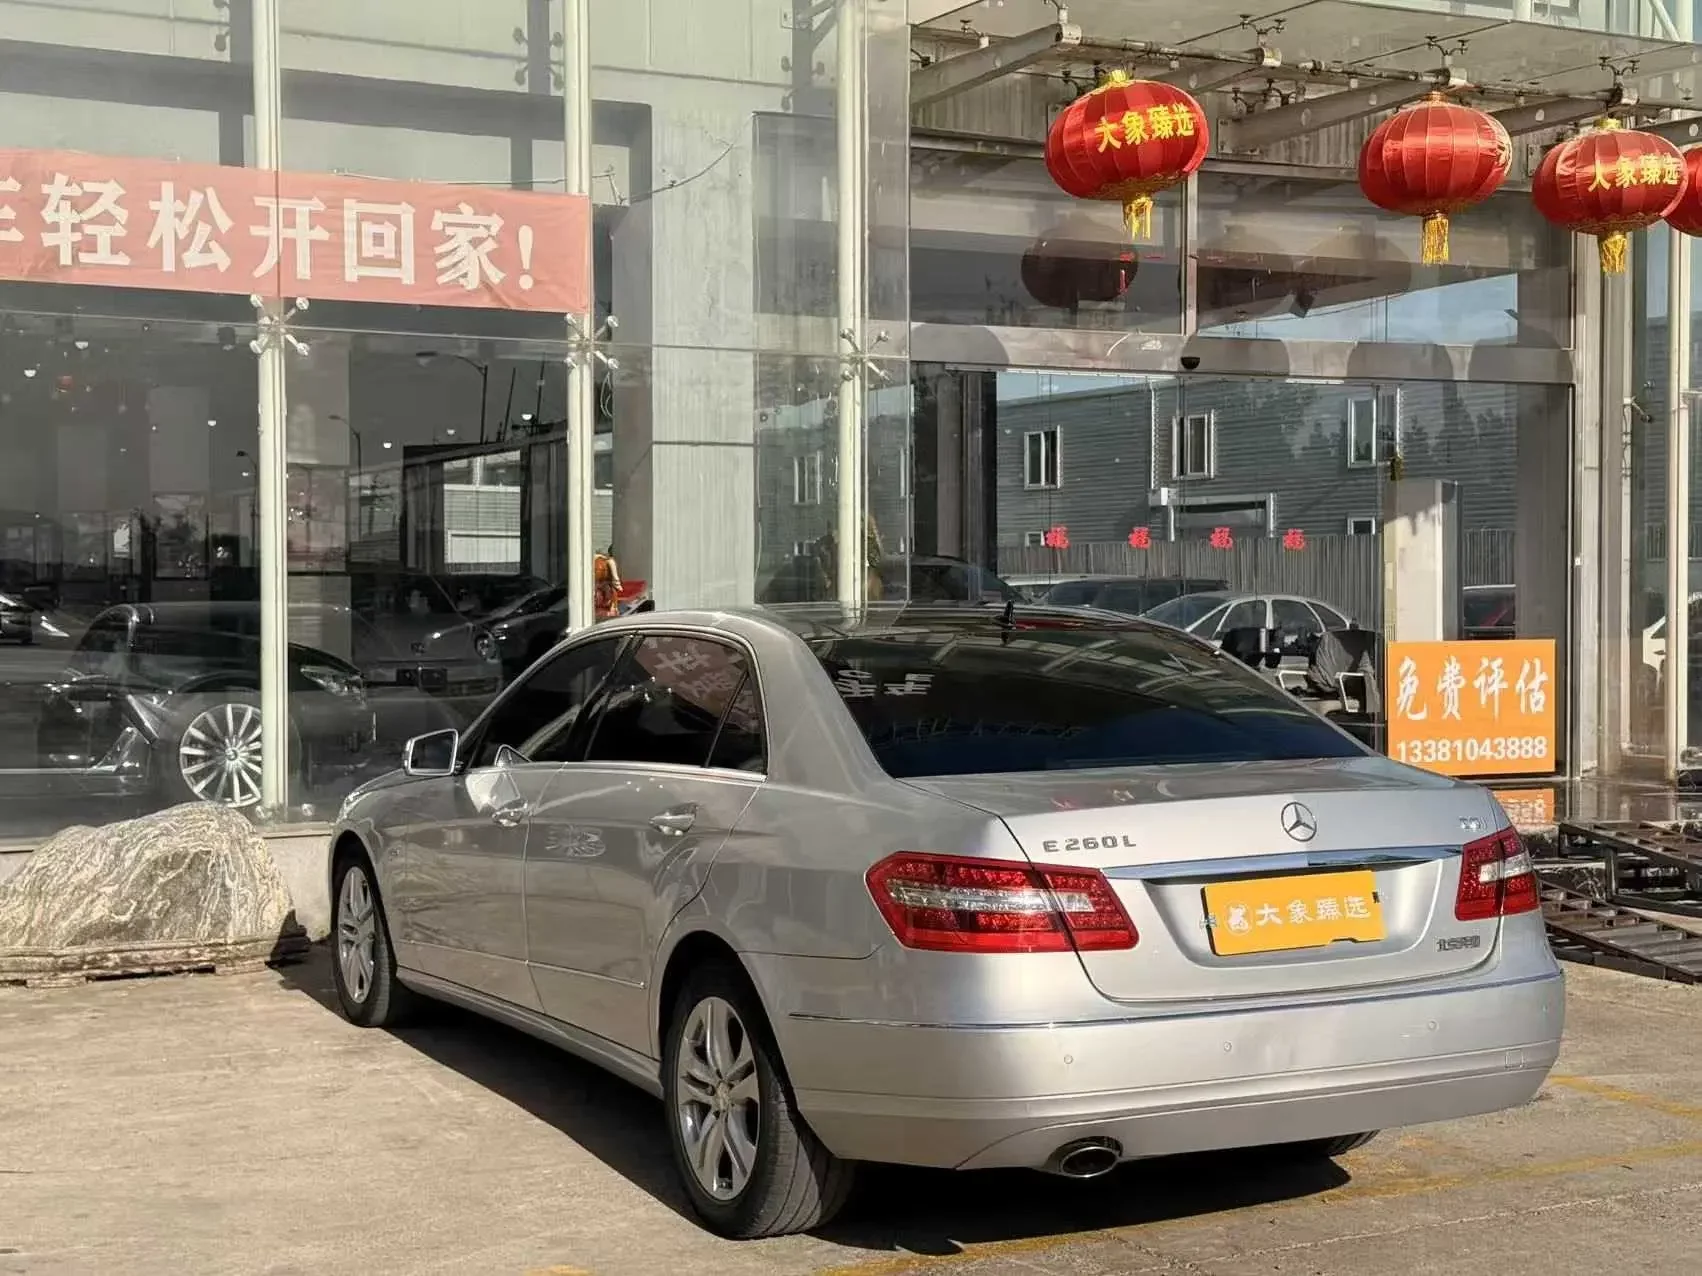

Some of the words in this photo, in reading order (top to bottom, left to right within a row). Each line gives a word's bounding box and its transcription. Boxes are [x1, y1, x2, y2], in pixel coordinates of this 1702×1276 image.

[1094, 102, 1196, 153] 大象臻选
[1396, 655, 1549, 721] 免费评估
[1396, 735, 1548, 763] 13381043888
